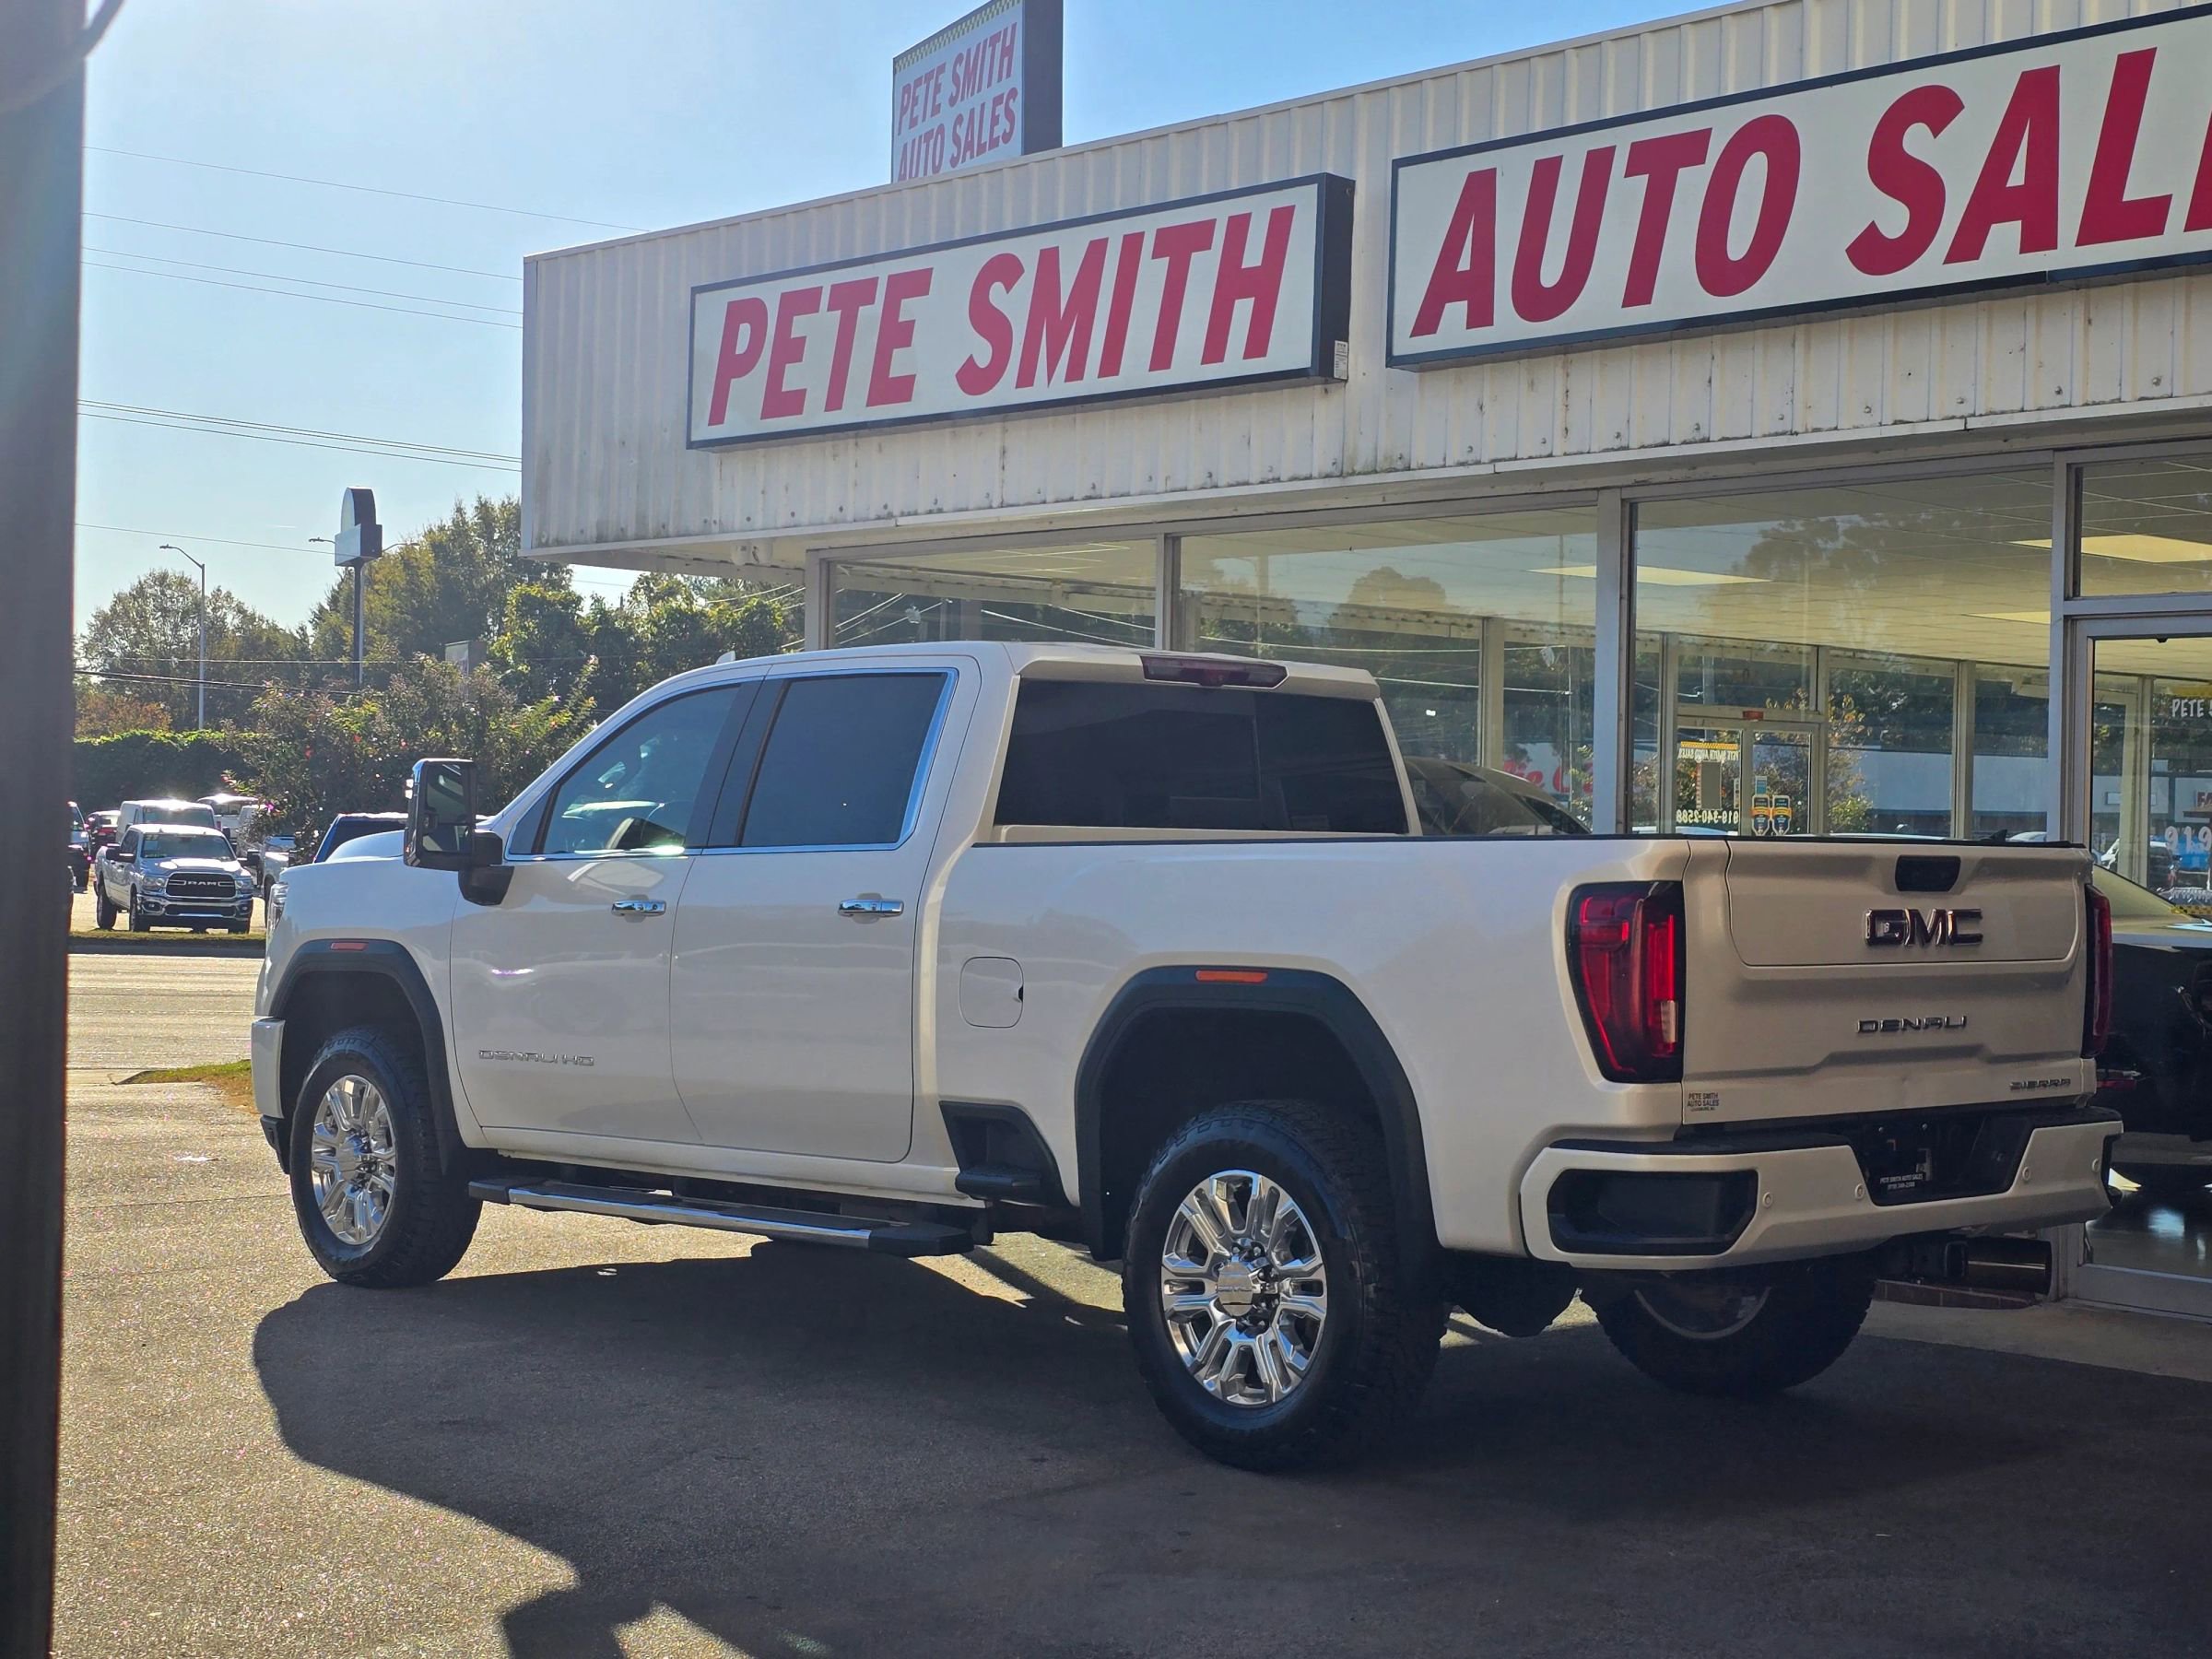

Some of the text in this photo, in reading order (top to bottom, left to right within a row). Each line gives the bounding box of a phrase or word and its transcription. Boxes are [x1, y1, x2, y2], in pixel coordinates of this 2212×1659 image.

[897, 21, 1018, 136] PETE SMITH
[898, 87, 1018, 182] AUTO SALES
[1409, 46, 2212, 338] AUTO SAL
[707, 205, 1296, 427] PETE SMITH
[2171, 699, 2205, 718] PETE
[1865, 908, 1983, 947] GMC
[1857, 1015, 1968, 1033] DENALI
